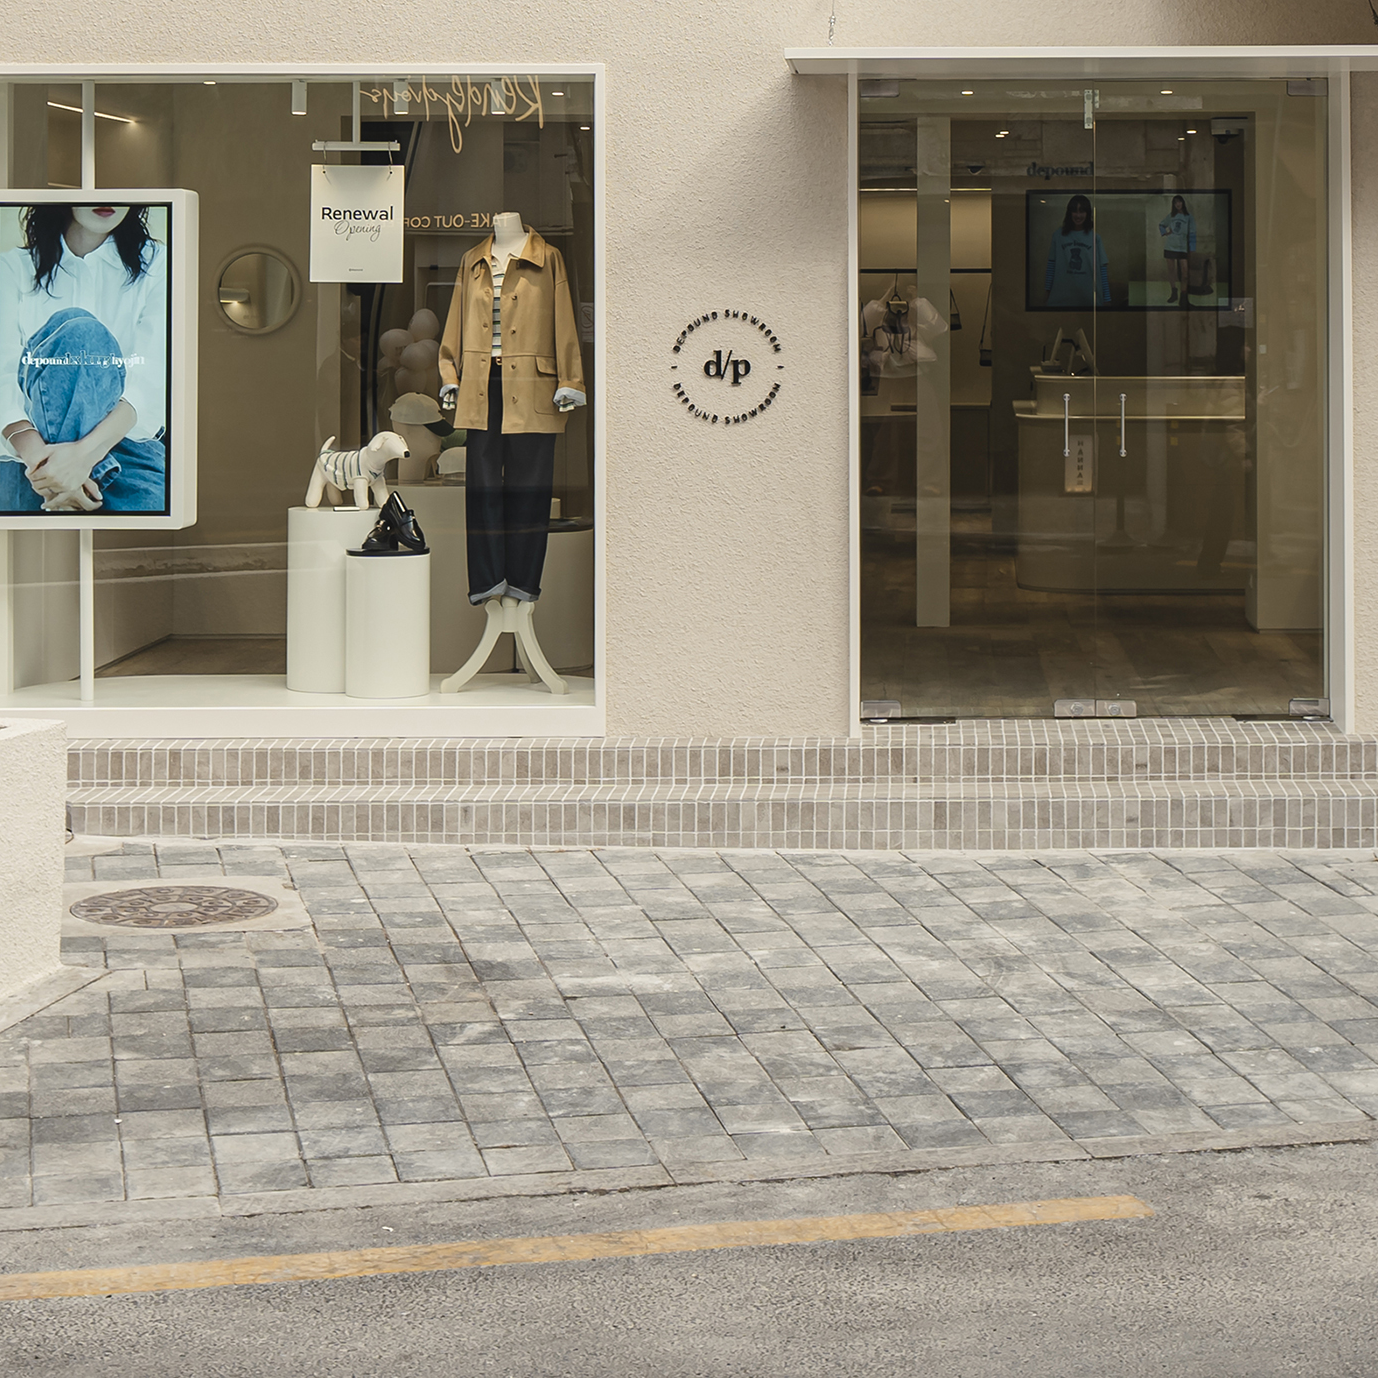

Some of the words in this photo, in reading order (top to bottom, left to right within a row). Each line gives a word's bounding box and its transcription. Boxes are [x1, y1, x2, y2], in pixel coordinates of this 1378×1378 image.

[321, 205, 394, 221] Renewal
[333, 220, 381, 243] Opening
[673, 311, 718, 353] DEPOUND
[725, 309, 781, 353] SHOWROOM
[703, 349, 751, 385] d/p
[673, 382, 718, 424] DEPOUND
[725, 382, 781, 425] SHOWROOM
